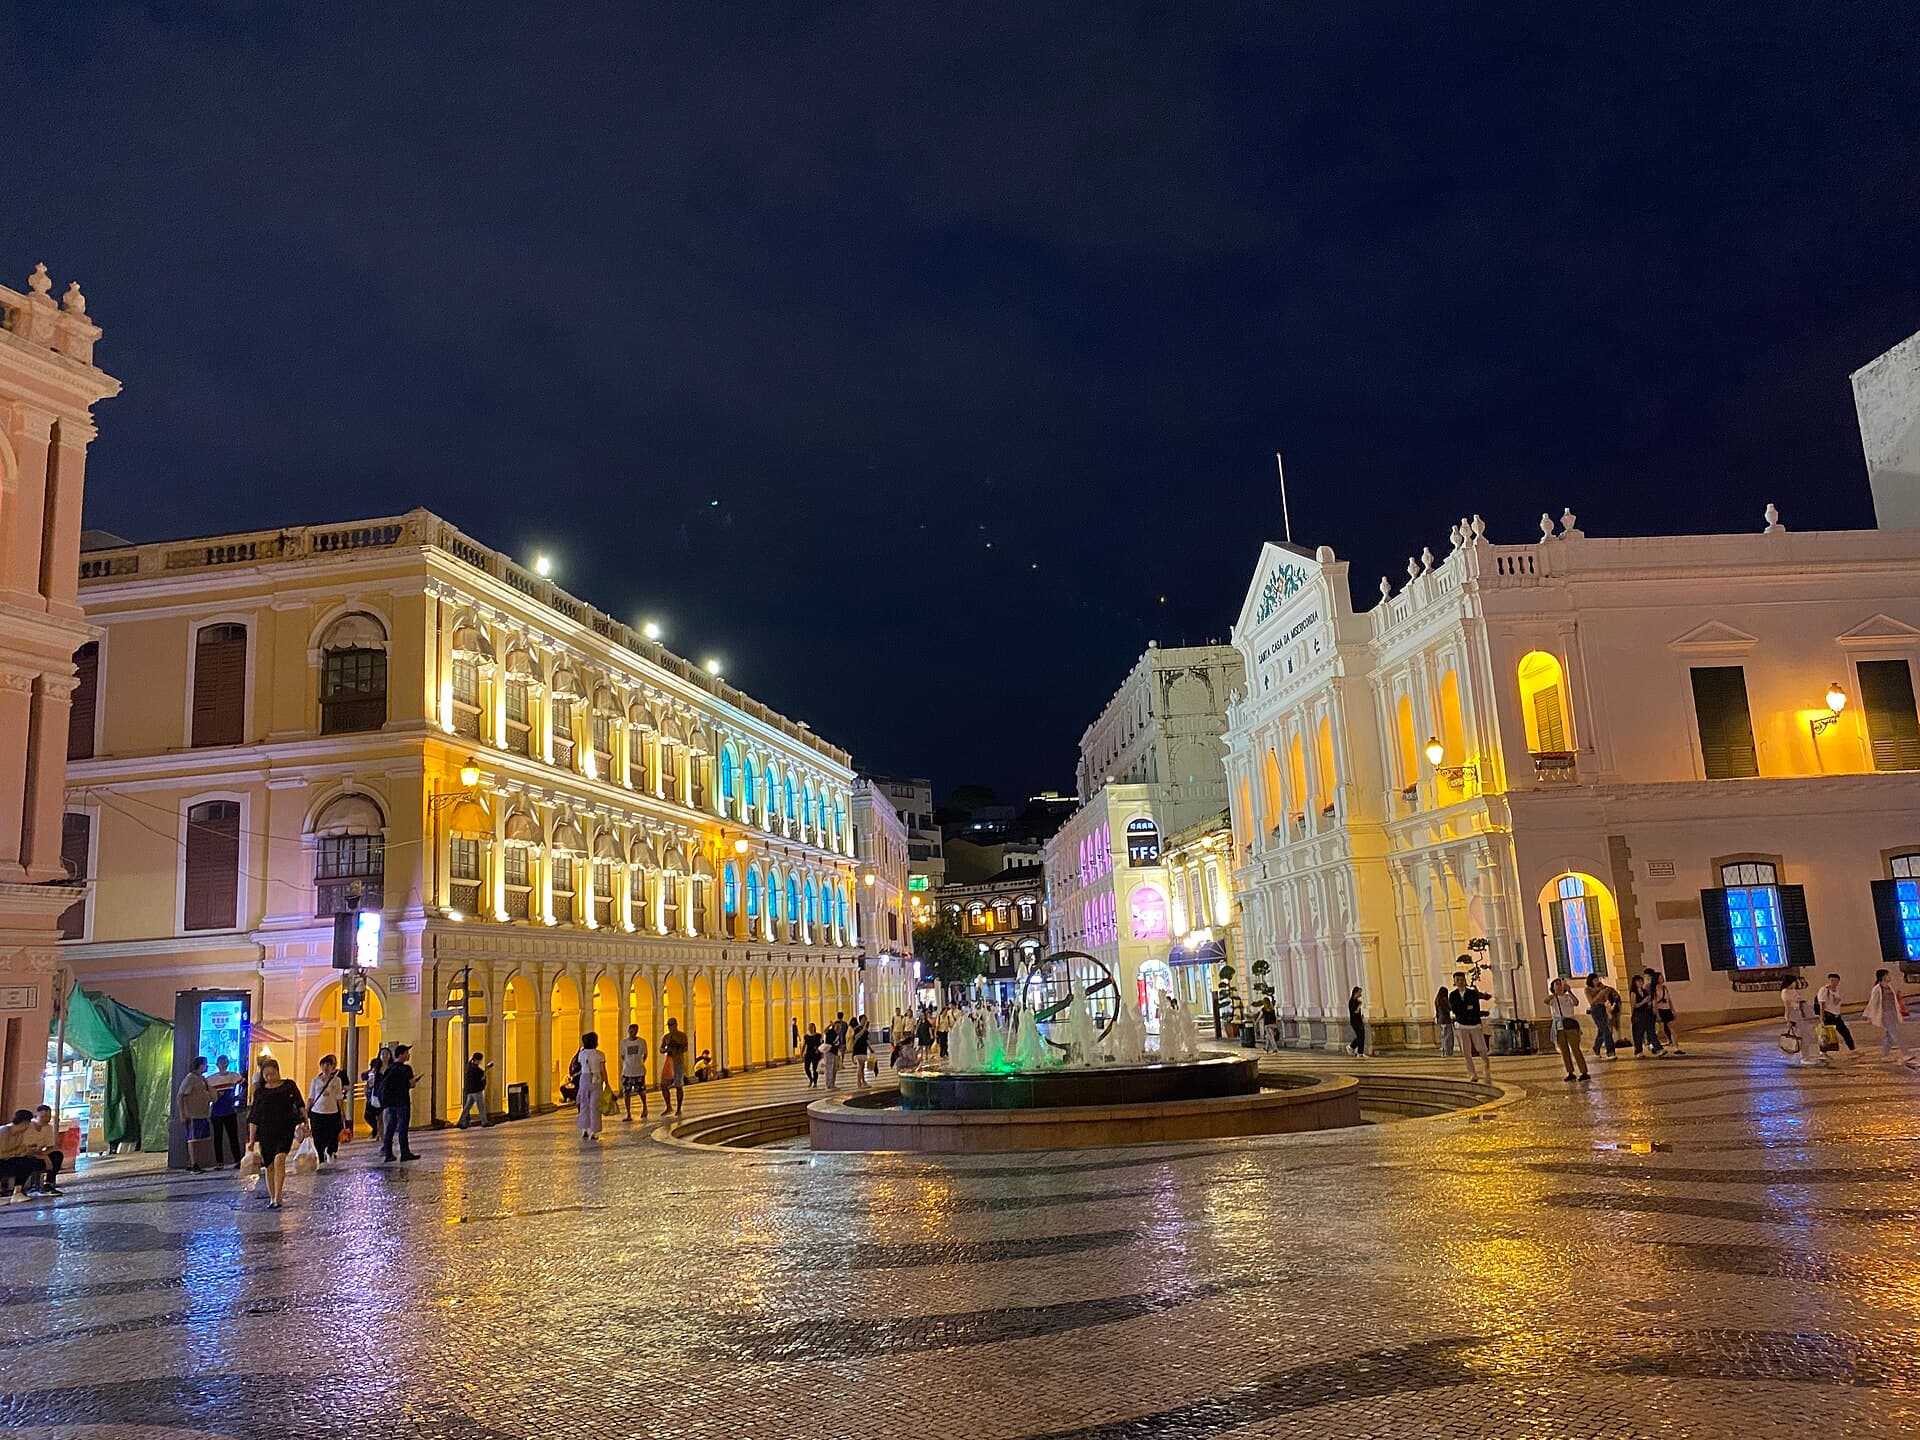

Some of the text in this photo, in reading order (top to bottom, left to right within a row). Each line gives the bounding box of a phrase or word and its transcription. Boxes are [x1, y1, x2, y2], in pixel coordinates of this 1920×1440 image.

[1258, 648, 1271, 664] SANTA
[1271, 638, 1284, 653] CASA
[1283, 633, 1290, 645] DA
[1130, 846, 1157, 860] TFS
